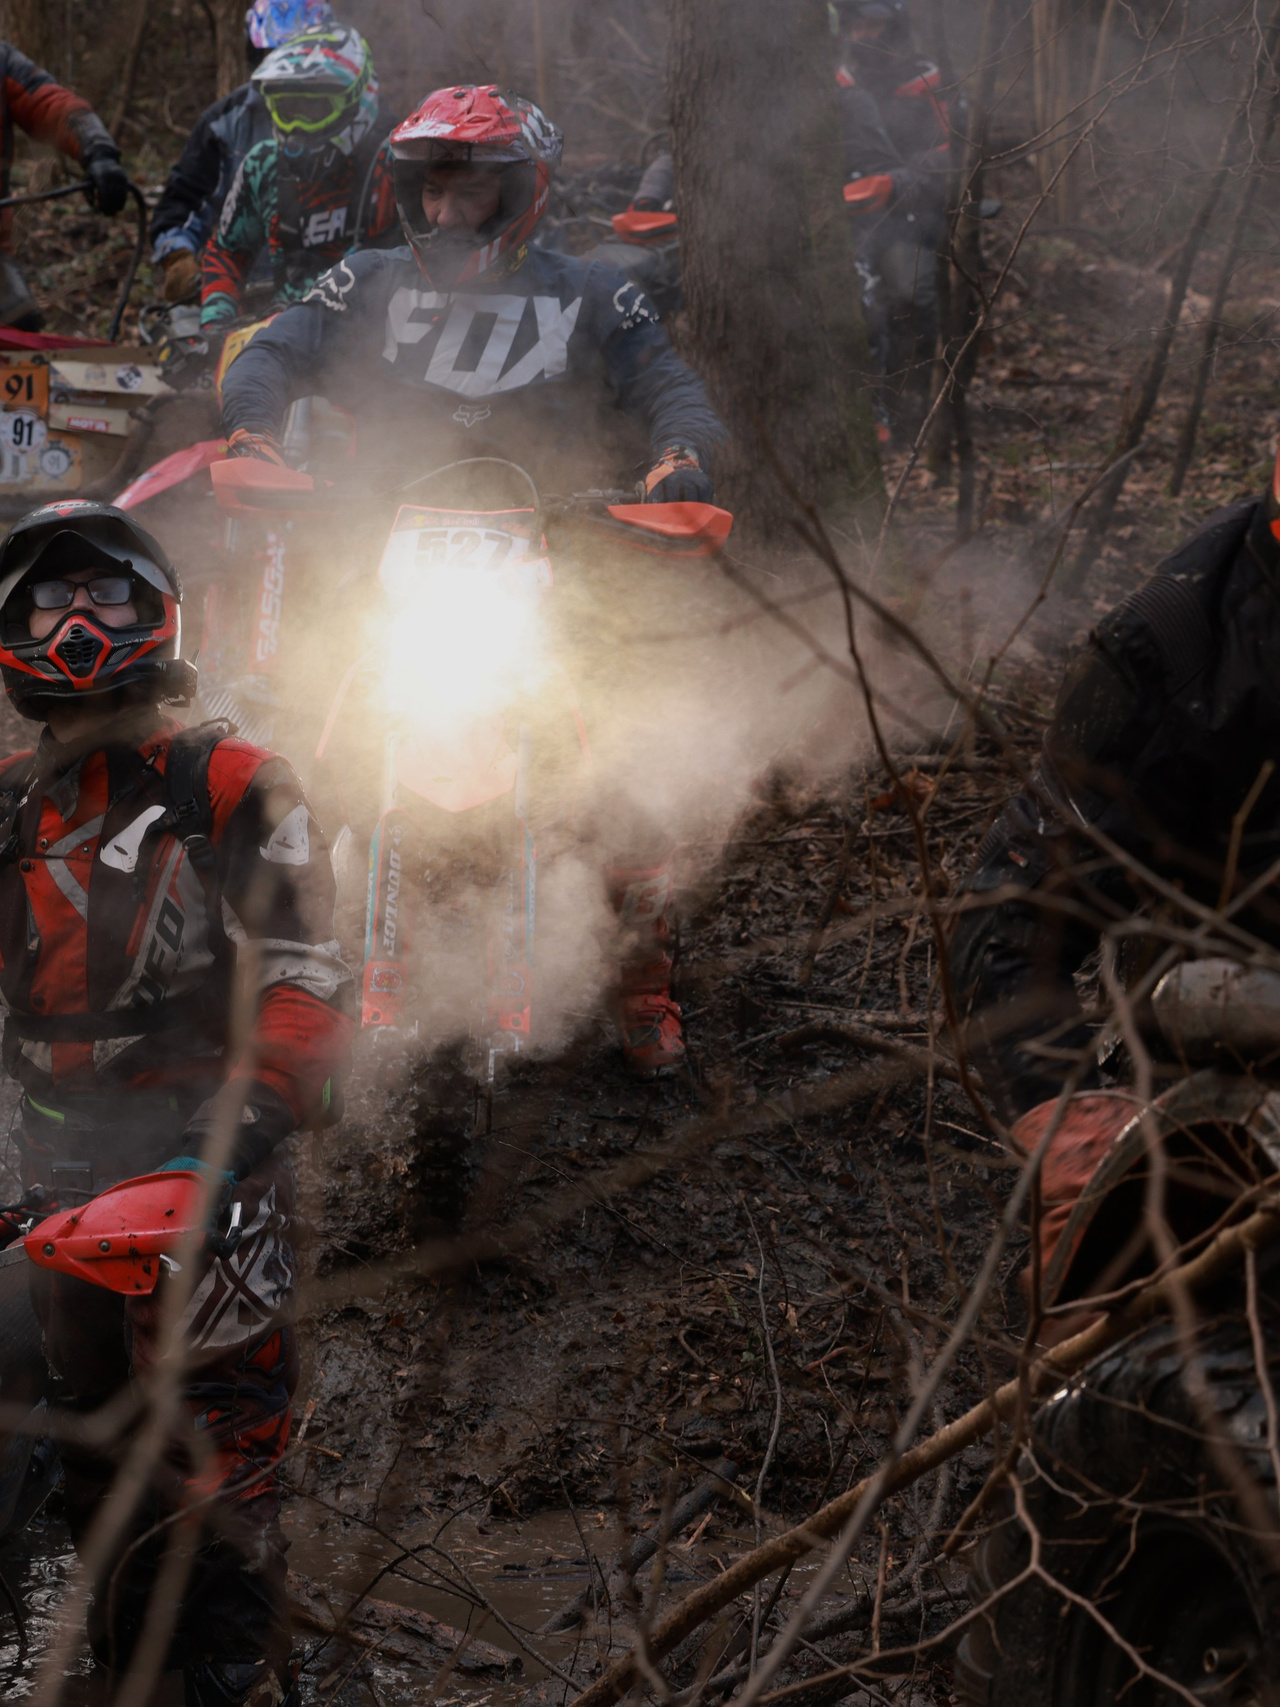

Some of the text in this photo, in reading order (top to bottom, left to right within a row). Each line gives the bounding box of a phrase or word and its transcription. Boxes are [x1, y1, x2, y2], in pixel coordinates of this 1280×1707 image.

[381, 287, 583, 399] FOX
[4, 374, 34, 402] 91
[12, 416, 34, 446] 91
[413, 530, 514, 572] 527
[130, 896, 185, 1008] UFO
